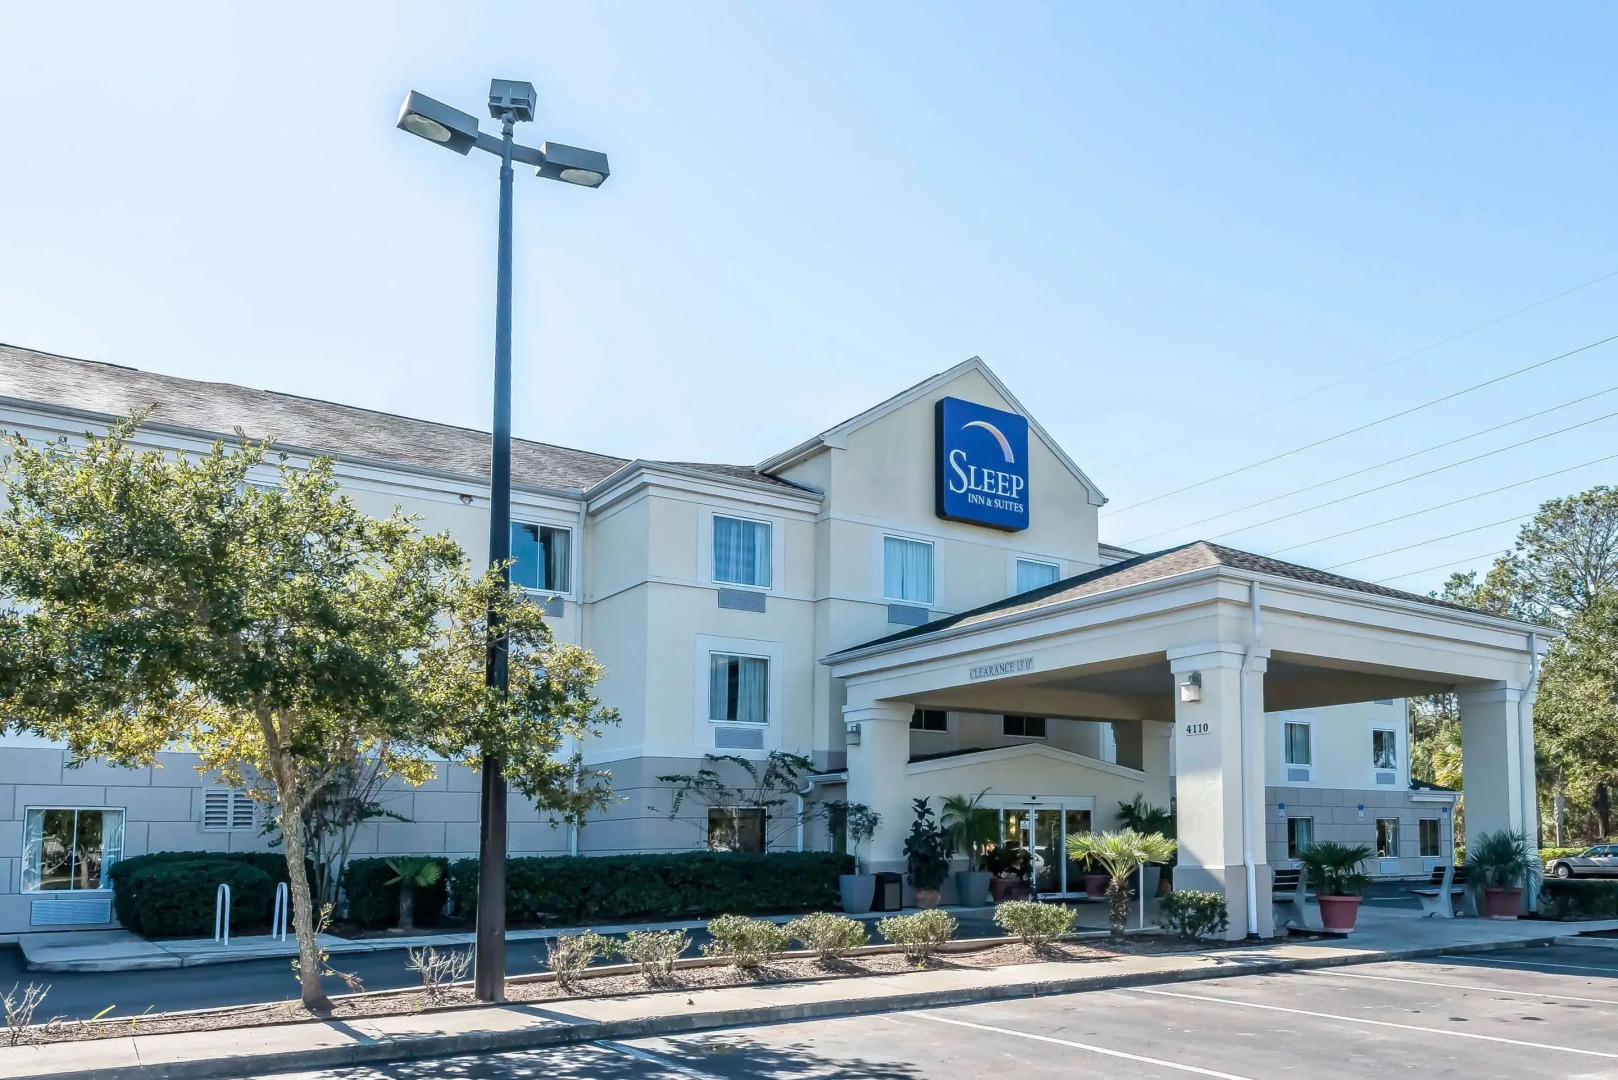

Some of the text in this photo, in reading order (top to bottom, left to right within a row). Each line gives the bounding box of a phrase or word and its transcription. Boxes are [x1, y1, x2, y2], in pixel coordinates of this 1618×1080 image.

[949, 449, 1024, 498] SLEEP
[968, 493, 1024, 513] INN & SUITES
[969, 661, 1014, 679] CLEARANCE
[1186, 723, 1208, 733] 4110
